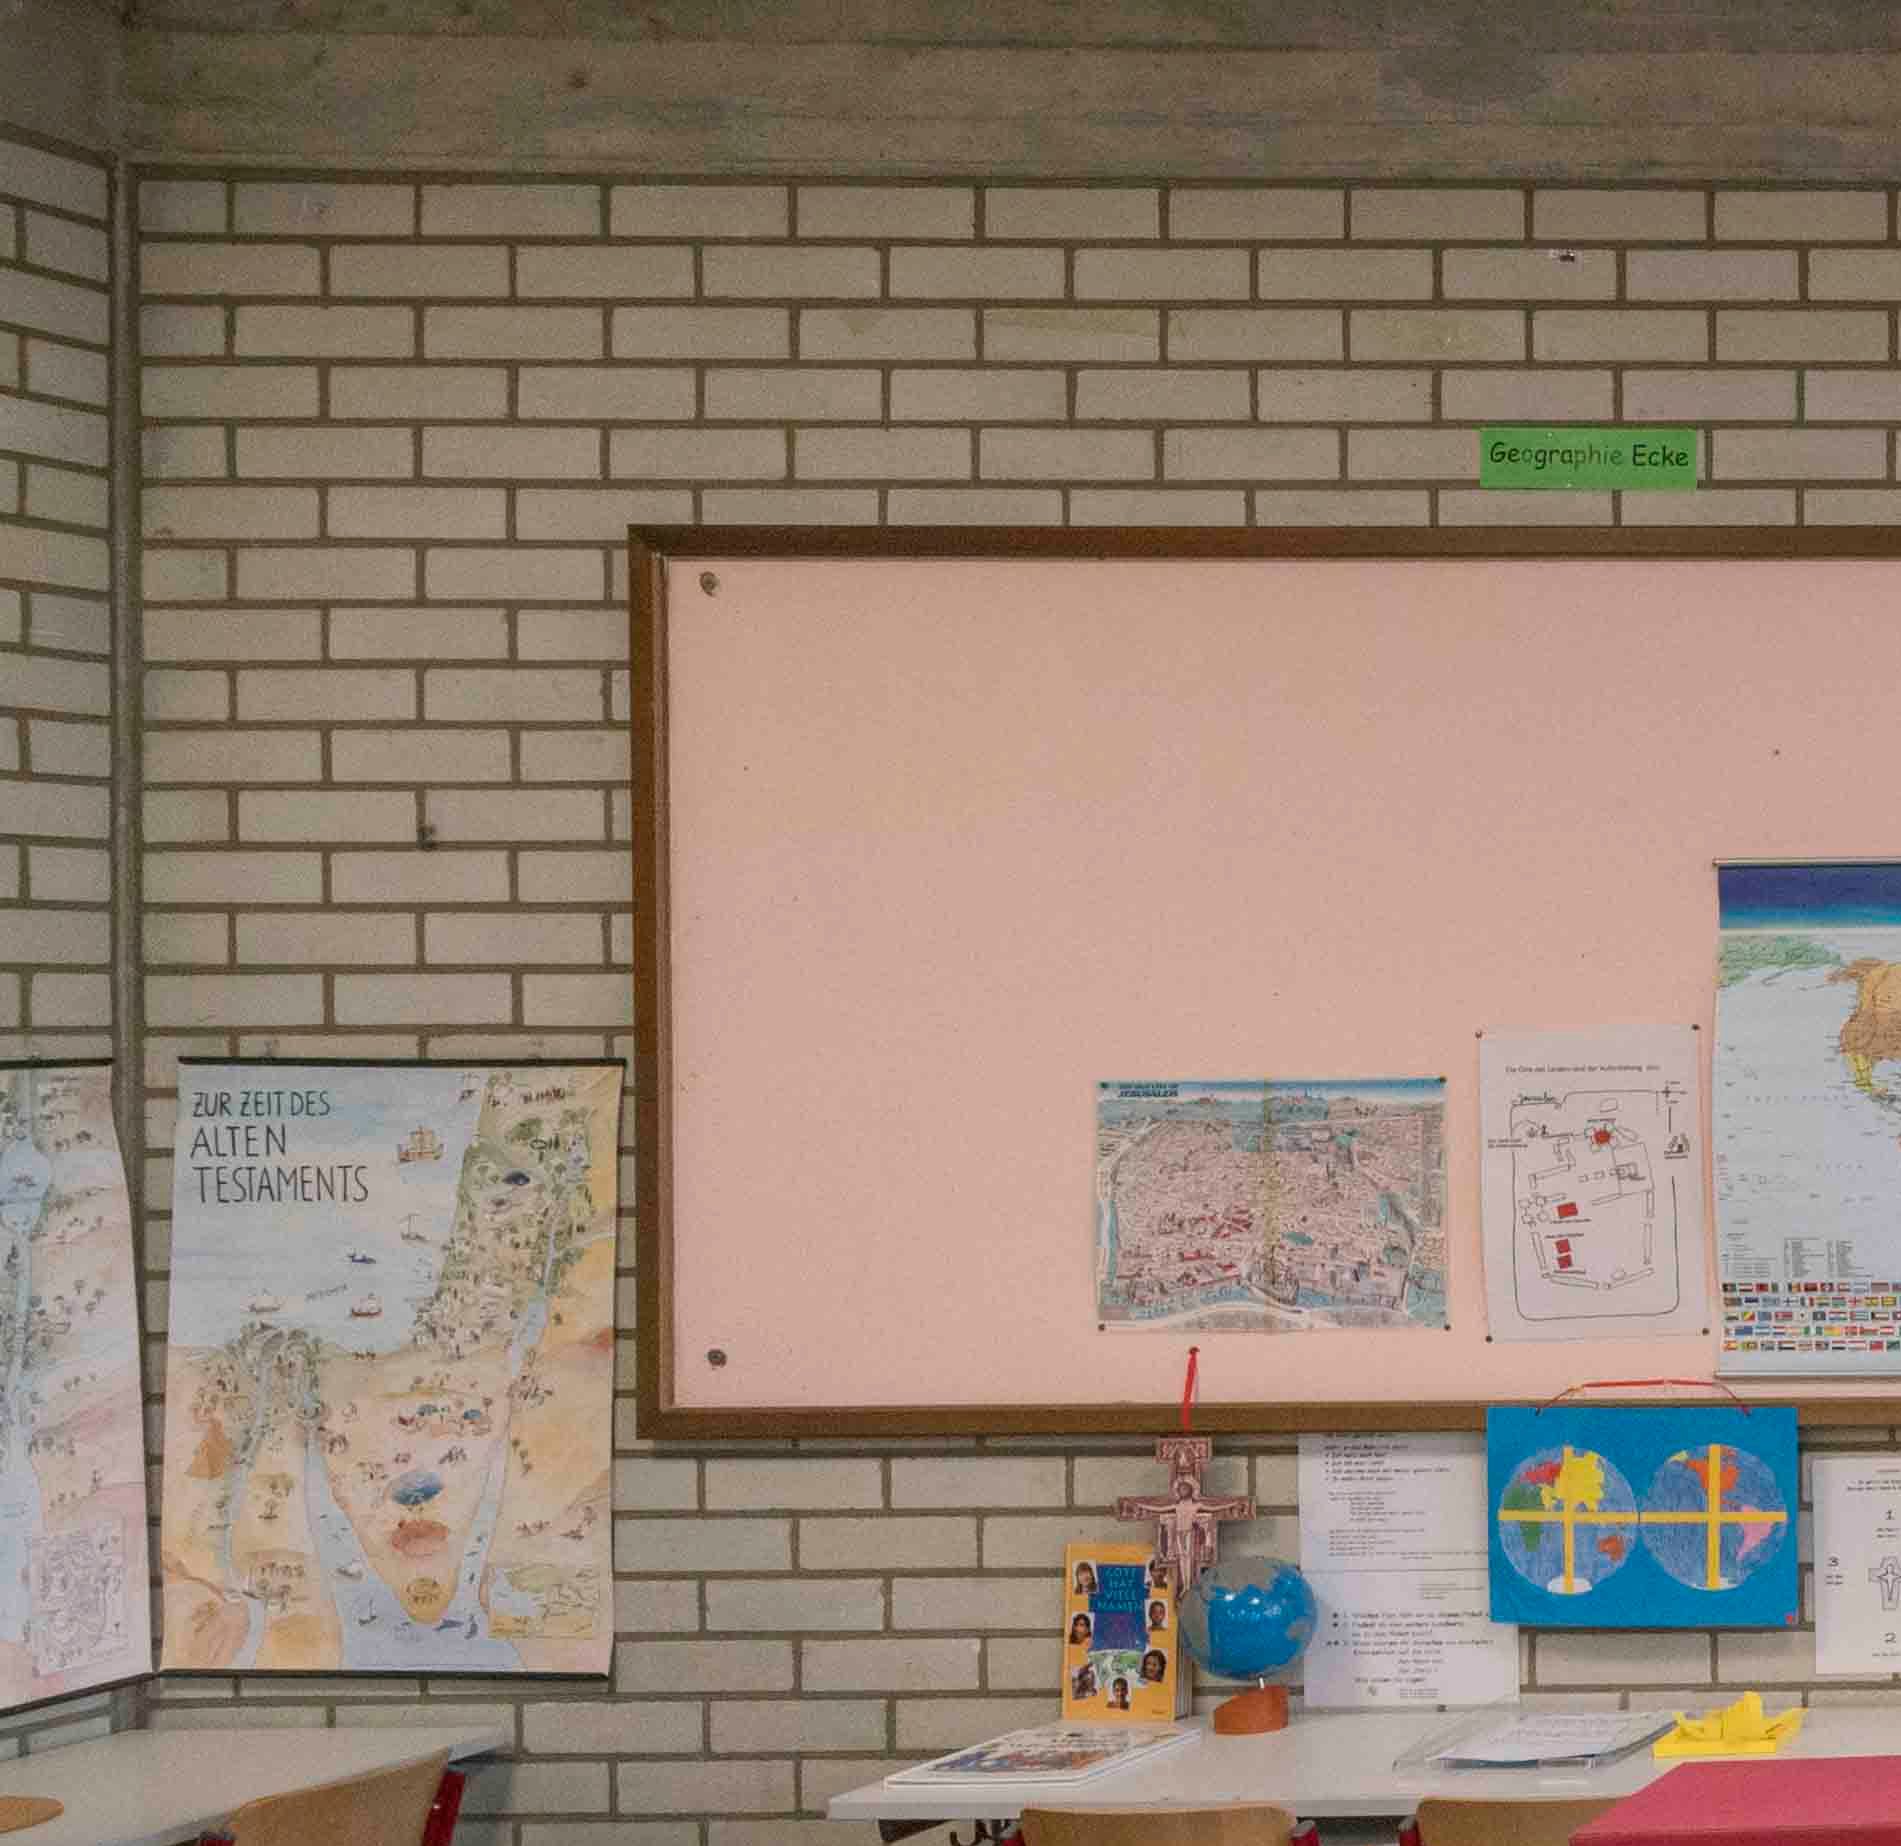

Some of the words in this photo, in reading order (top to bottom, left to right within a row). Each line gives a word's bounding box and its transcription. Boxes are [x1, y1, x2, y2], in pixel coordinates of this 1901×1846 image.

[1489, 441, 1624, 469] Geographie
[1631, 443, 1689, 467] Ecke
[192, 1091, 232, 1117] ZUR
[239, 1090, 285, 1117] ZEIT
[289, 1090, 331, 1116] DES
[190, 1123, 287, 1158] ALTEN
[192, 1164, 369, 1203] TESTAMENTS
[1884, 1509, 1895, 1521] 1
[1827, 1556, 1840, 1567] 3
[1884, 1632, 1897, 1644] 2
